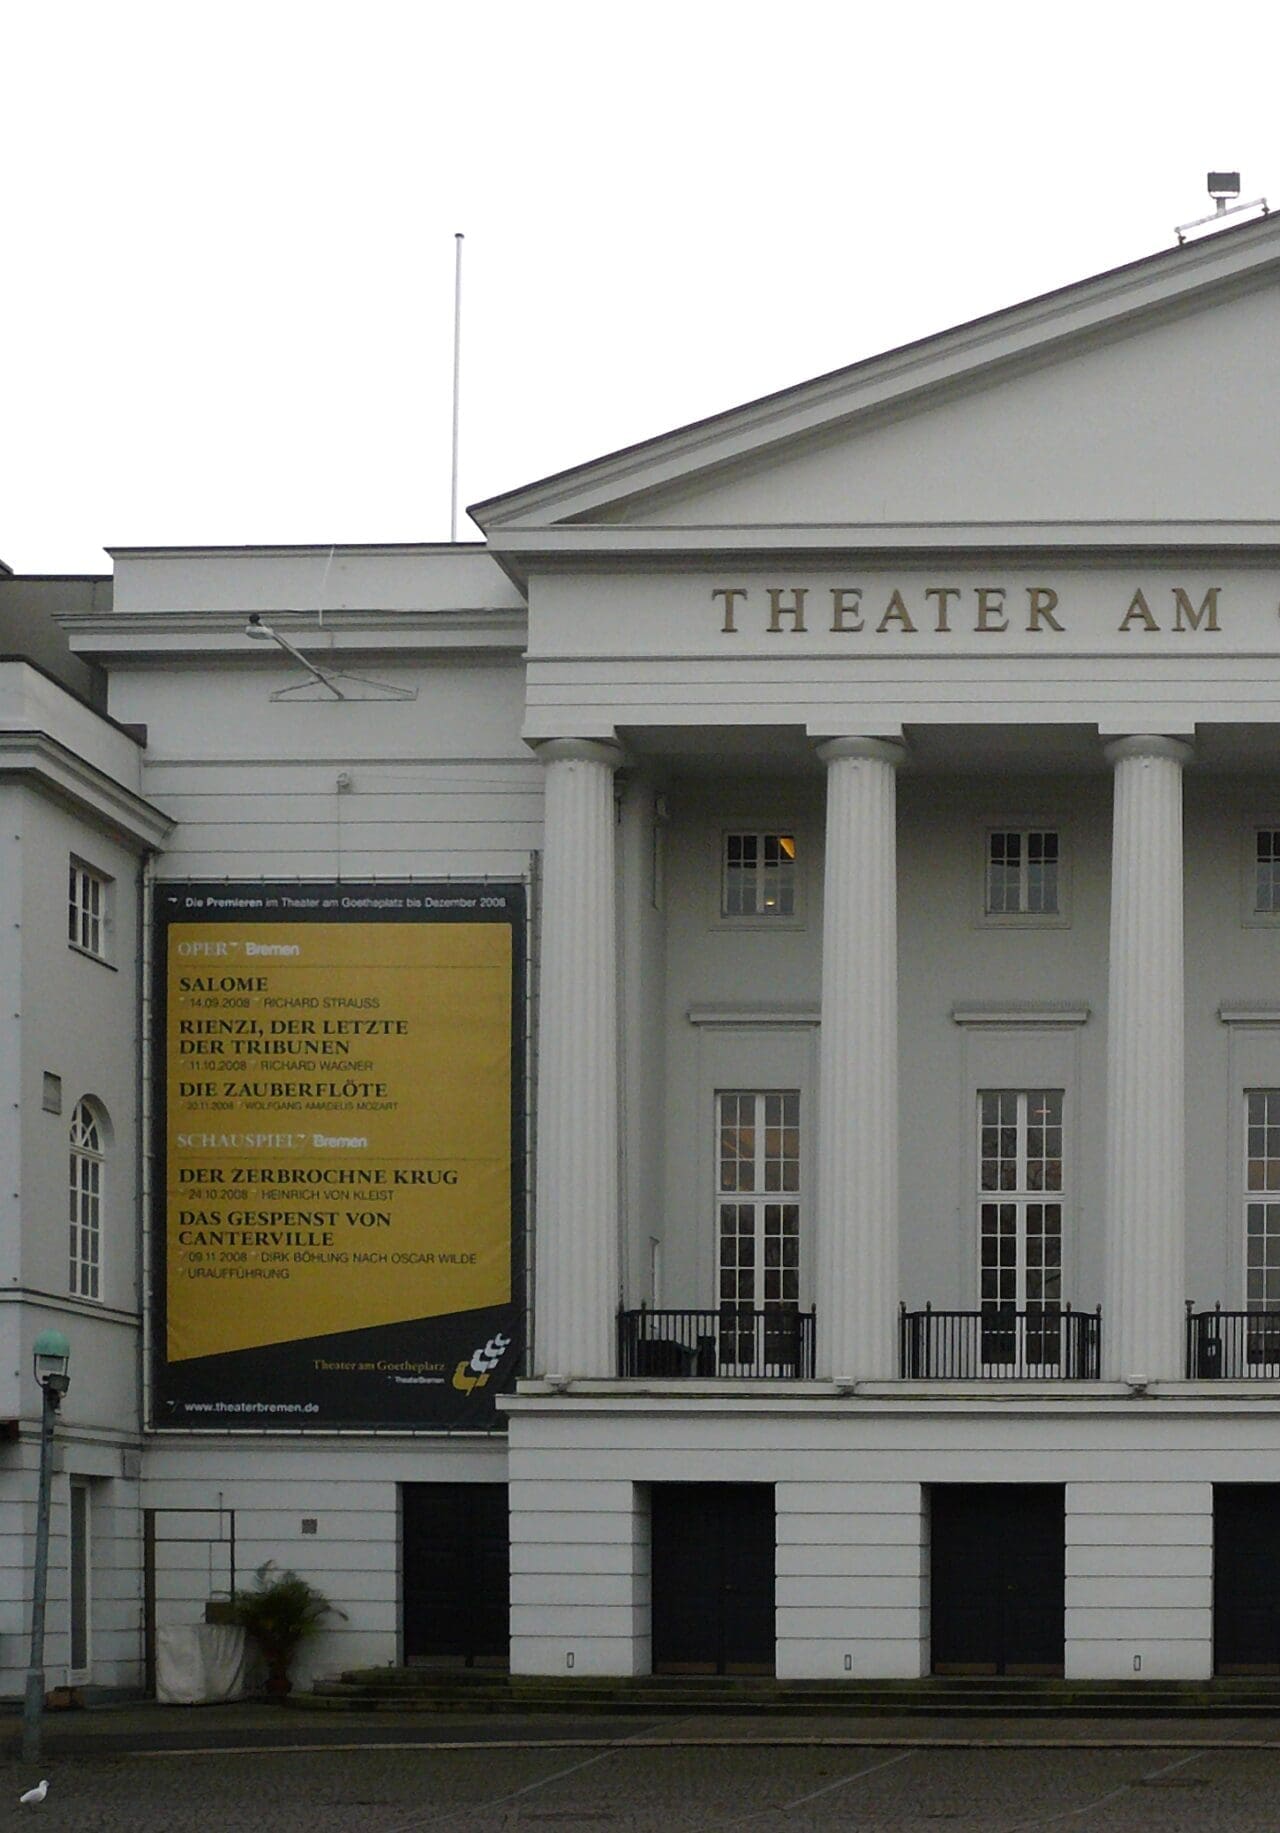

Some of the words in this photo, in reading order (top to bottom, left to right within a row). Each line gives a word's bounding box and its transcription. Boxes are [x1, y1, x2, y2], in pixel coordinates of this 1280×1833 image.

[712, 587, 1066, 633] THEATER
[1118, 587, 1222, 632] AM
[207, 897, 263, 907] Premieren
[177, 942, 227, 957] OPER
[246, 942, 300, 957] Bremen
[179, 977, 268, 992] SALOME
[264, 998, 319, 1009] RICHARD
[323, 998, 380, 1009] STRAUSS
[179, 1020, 264, 1038] RIENZI,
[271, 1020, 316, 1036] DER
[323, 1020, 408, 1036] LETZTE
[179, 1040, 225, 1055] DER
[231, 1040, 350, 1055] TRIBUNEN
[190, 1061, 246, 1071] 11.10.2008
[261, 1061, 316, 1071] RICHARD
[319, 1061, 373, 1071] WAGNER
[179, 1083, 217, 1098] DIE
[223, 1079, 388, 1098] ZAUBERFLÖTE
[177, 1135, 298, 1148] SCHAUSPIEL
[313, 1135, 367, 1148] Bremen
[178, 1169, 225, 1185] DER
[232, 1169, 386, 1185] ZERBROCHNE
[394, 1169, 458, 1185] KRUG
[261, 1190, 319, 1201] HEINRICH
[323, 1190, 349, 1201] VON
[353, 1190, 394, 1201] KLEIST
[178, 1211, 221, 1227] DAS
[227, 1211, 339, 1227] GESPENST
[346, 1211, 391, 1227] VON
[178, 1231, 334, 1247] CANTERVILLE
[353, 1253, 387, 1264] NACH
[391, 1253, 434, 1264] OSCAR
[438, 1253, 477, 1264] WILDE
[188, 1268, 290, 1279] URAUFFÜHRUNG
[313, 1360, 356, 1371] Theater
[185, 1402, 319, 1413] www.theaterbremen.de
